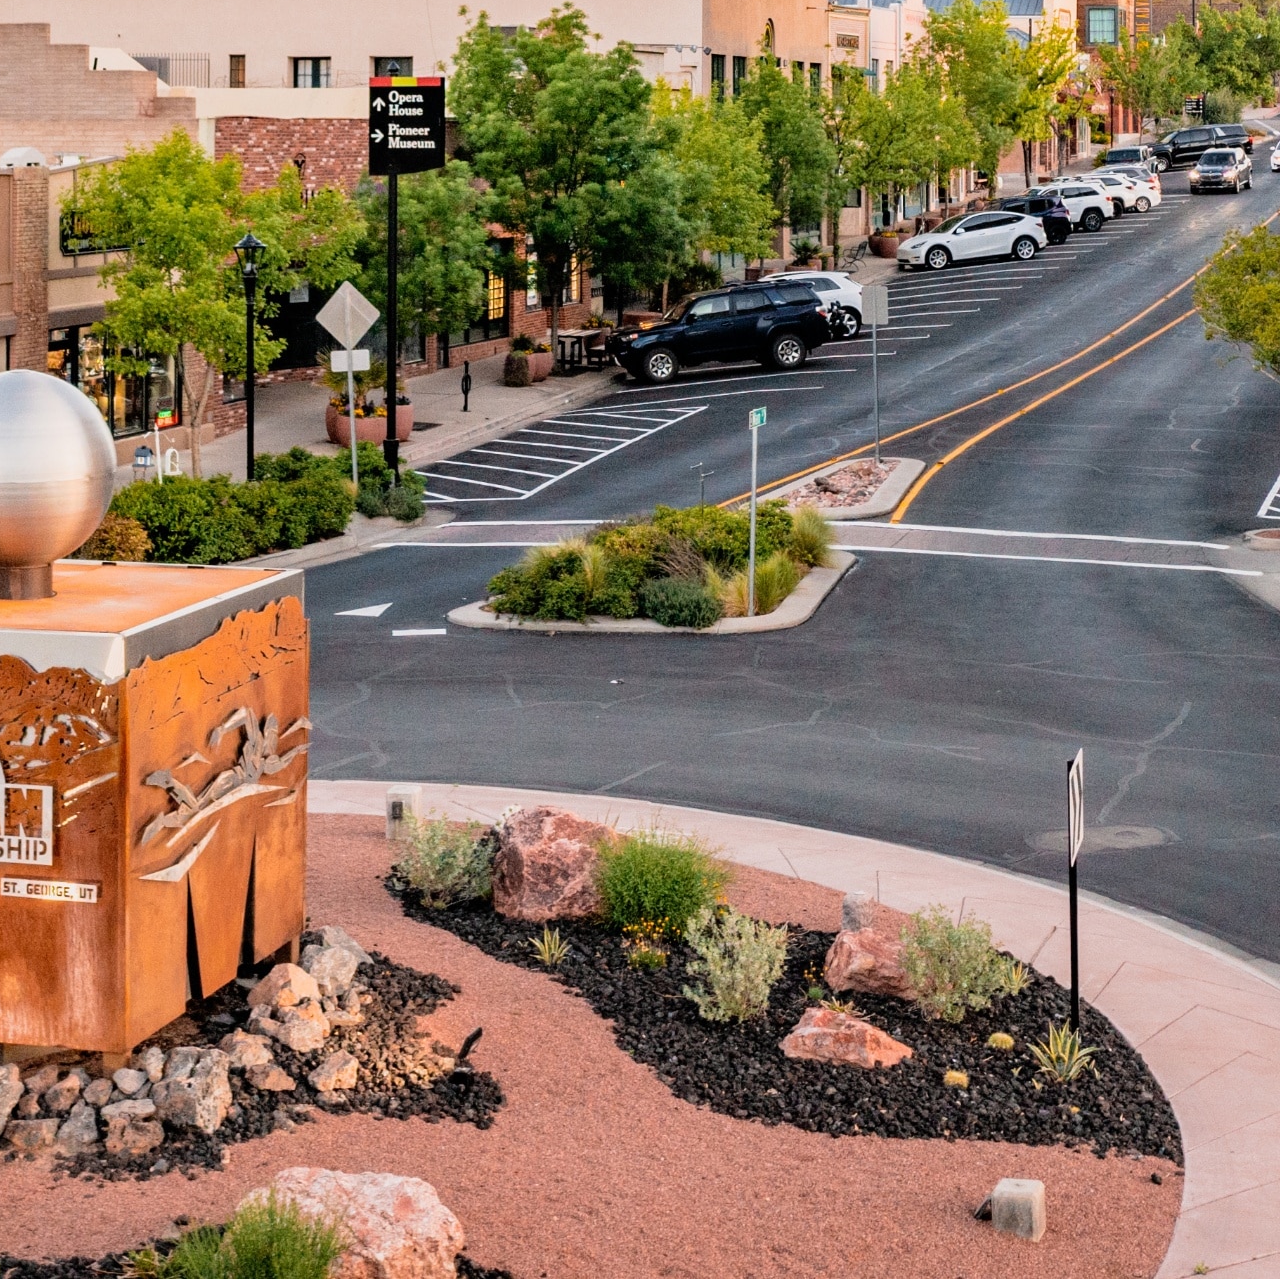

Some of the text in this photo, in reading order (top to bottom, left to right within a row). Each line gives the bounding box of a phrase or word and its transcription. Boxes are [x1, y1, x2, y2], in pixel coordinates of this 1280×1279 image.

[388, 90, 424, 105] Opera
[388, 104, 424, 116] House
[388, 123, 431, 136] Pioneer
[388, 136, 436, 149] Museum
[2, 881, 94, 900] ST. GEORGE, UT
